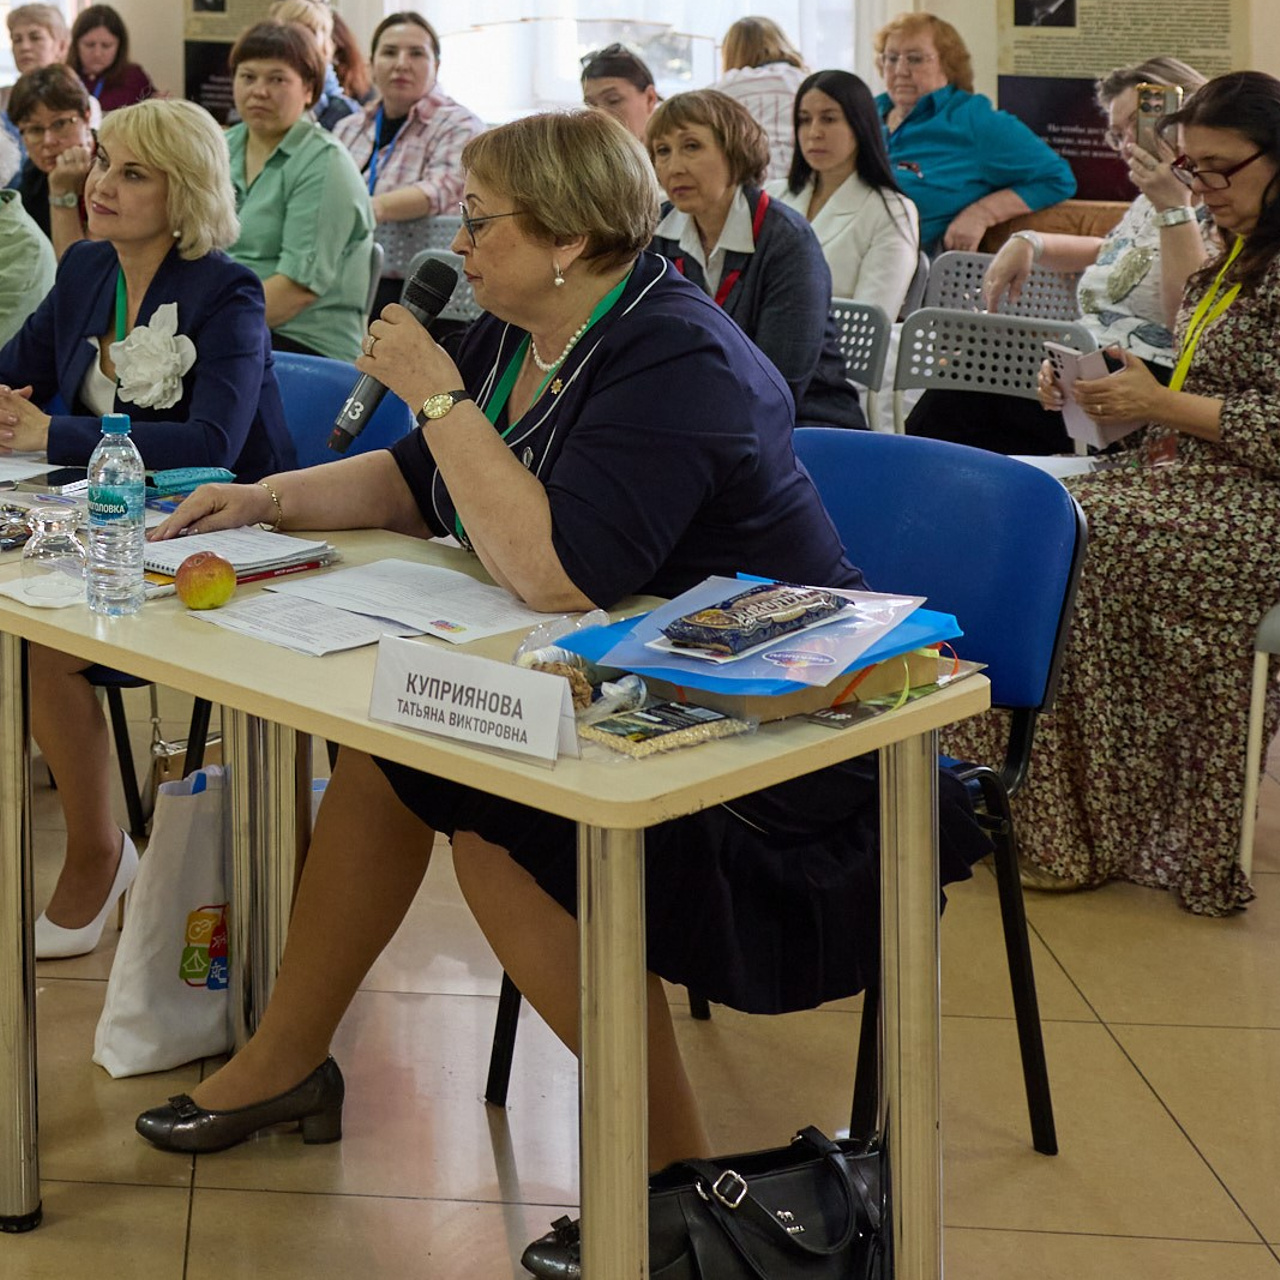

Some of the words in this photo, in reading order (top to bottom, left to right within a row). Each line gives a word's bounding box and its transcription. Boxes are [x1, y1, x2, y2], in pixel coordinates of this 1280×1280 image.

[343, 397, 365, 420] 13
[405, 672, 523, 720] КУПРИЯНОВА
[397, 698, 445, 724] ТАТЬЯНА
[448, 712, 528, 744] ВИКТОРОВНА
